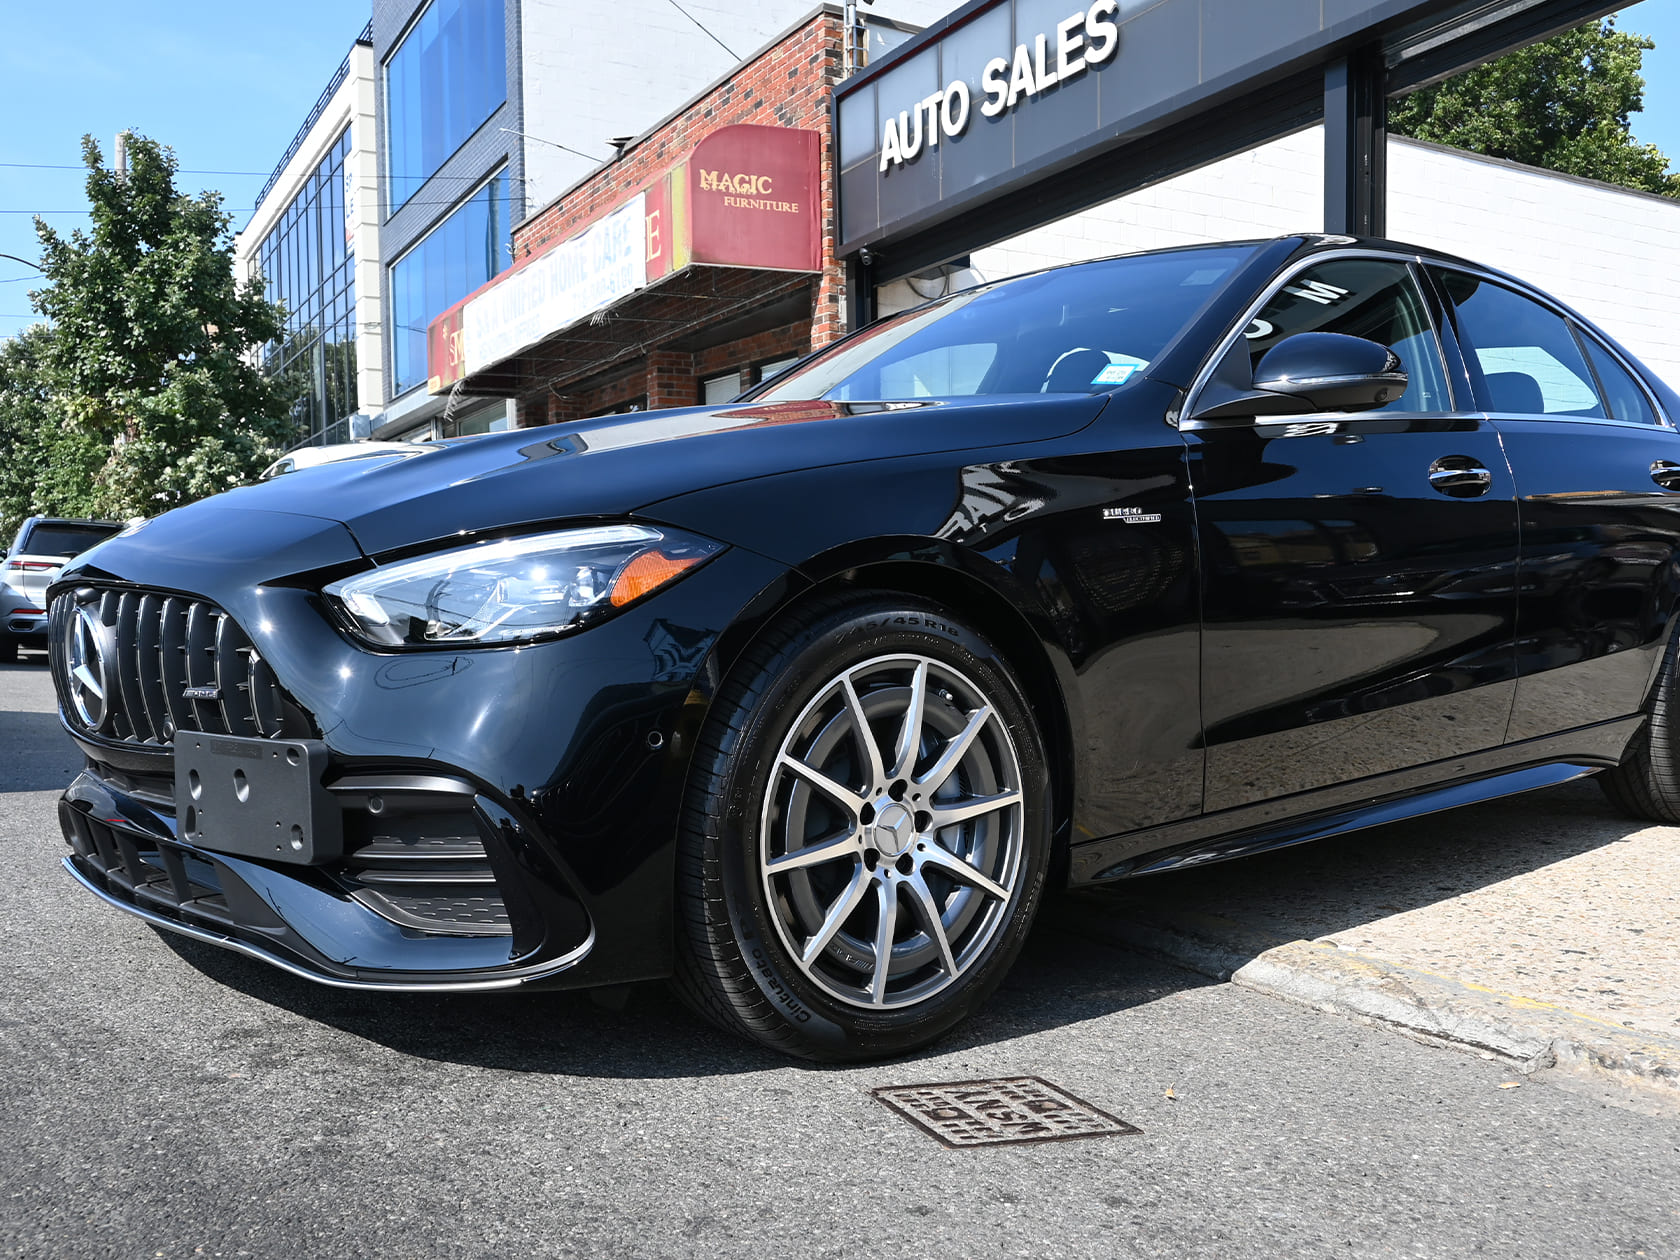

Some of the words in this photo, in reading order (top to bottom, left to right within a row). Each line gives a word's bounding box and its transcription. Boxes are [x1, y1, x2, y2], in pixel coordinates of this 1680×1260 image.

[879, 79, 970, 173] AUTO
[980, 0, 1119, 118] SALES
[699, 168, 773, 194] MAGIC
[723, 195, 799, 213] FURNITURE
[549, 240, 589, 297] HOME
[592, 216, 632, 273] CARE
[924, 618, 960, 637] R18
[751, 947, 812, 1024] Cinturato
